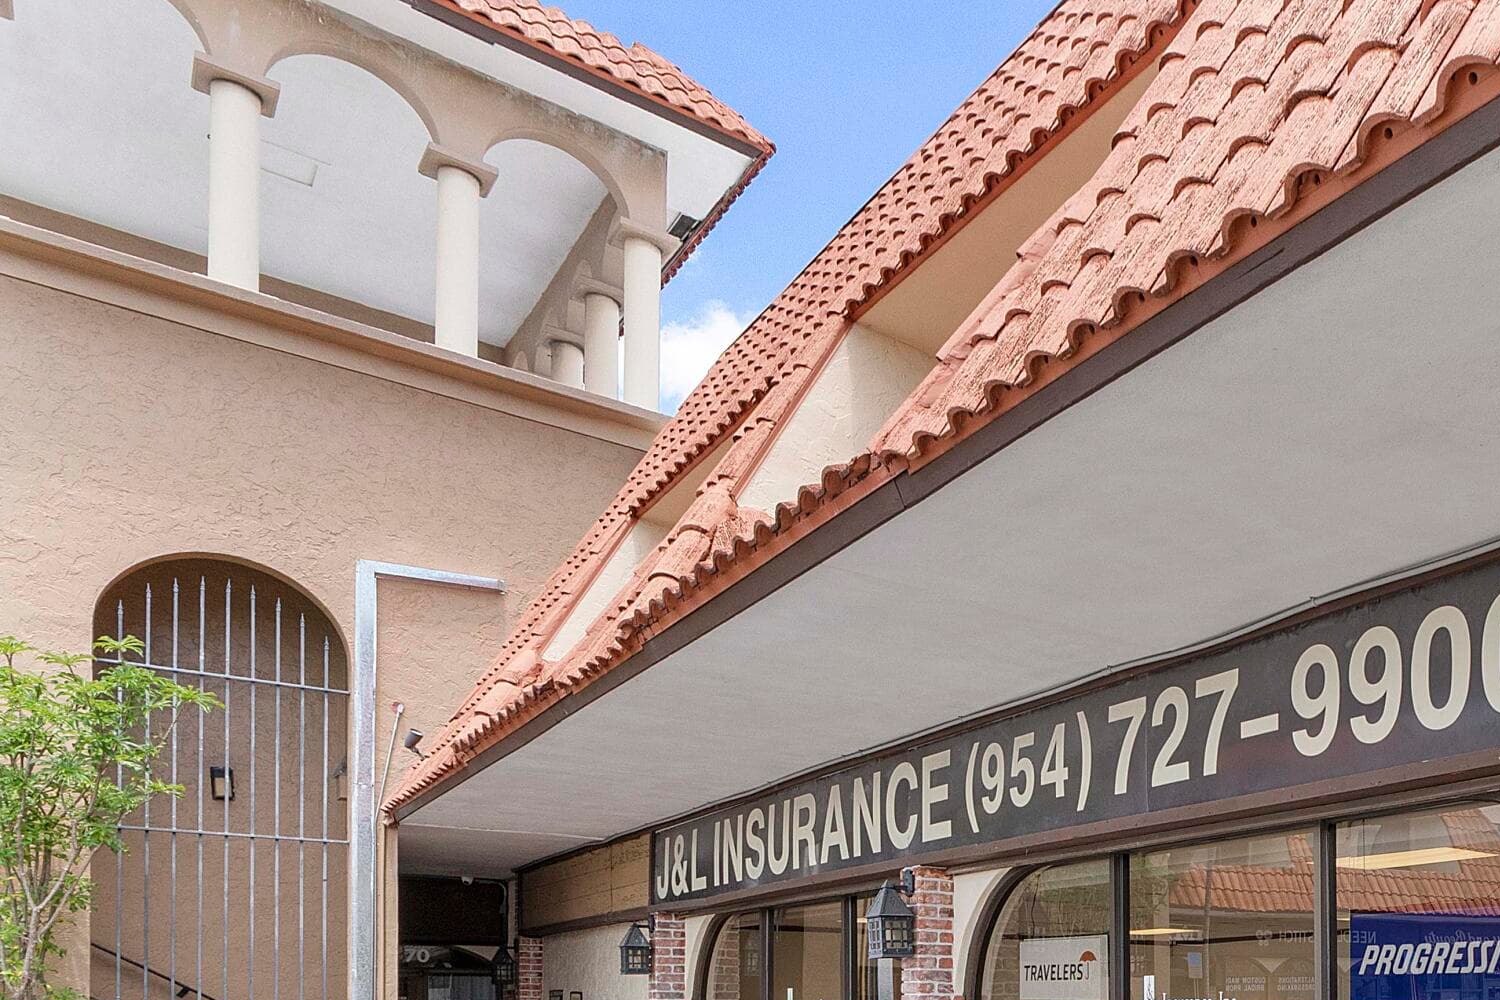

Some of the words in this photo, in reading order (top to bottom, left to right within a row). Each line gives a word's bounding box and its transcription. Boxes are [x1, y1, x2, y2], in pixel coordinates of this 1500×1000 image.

[656, 829, 707, 899] J&L
[713, 750, 952, 887] INSURANCE
[965, 711, 1092, 833] (954)
[1024, 963, 1083, 981] TRAVELERS
